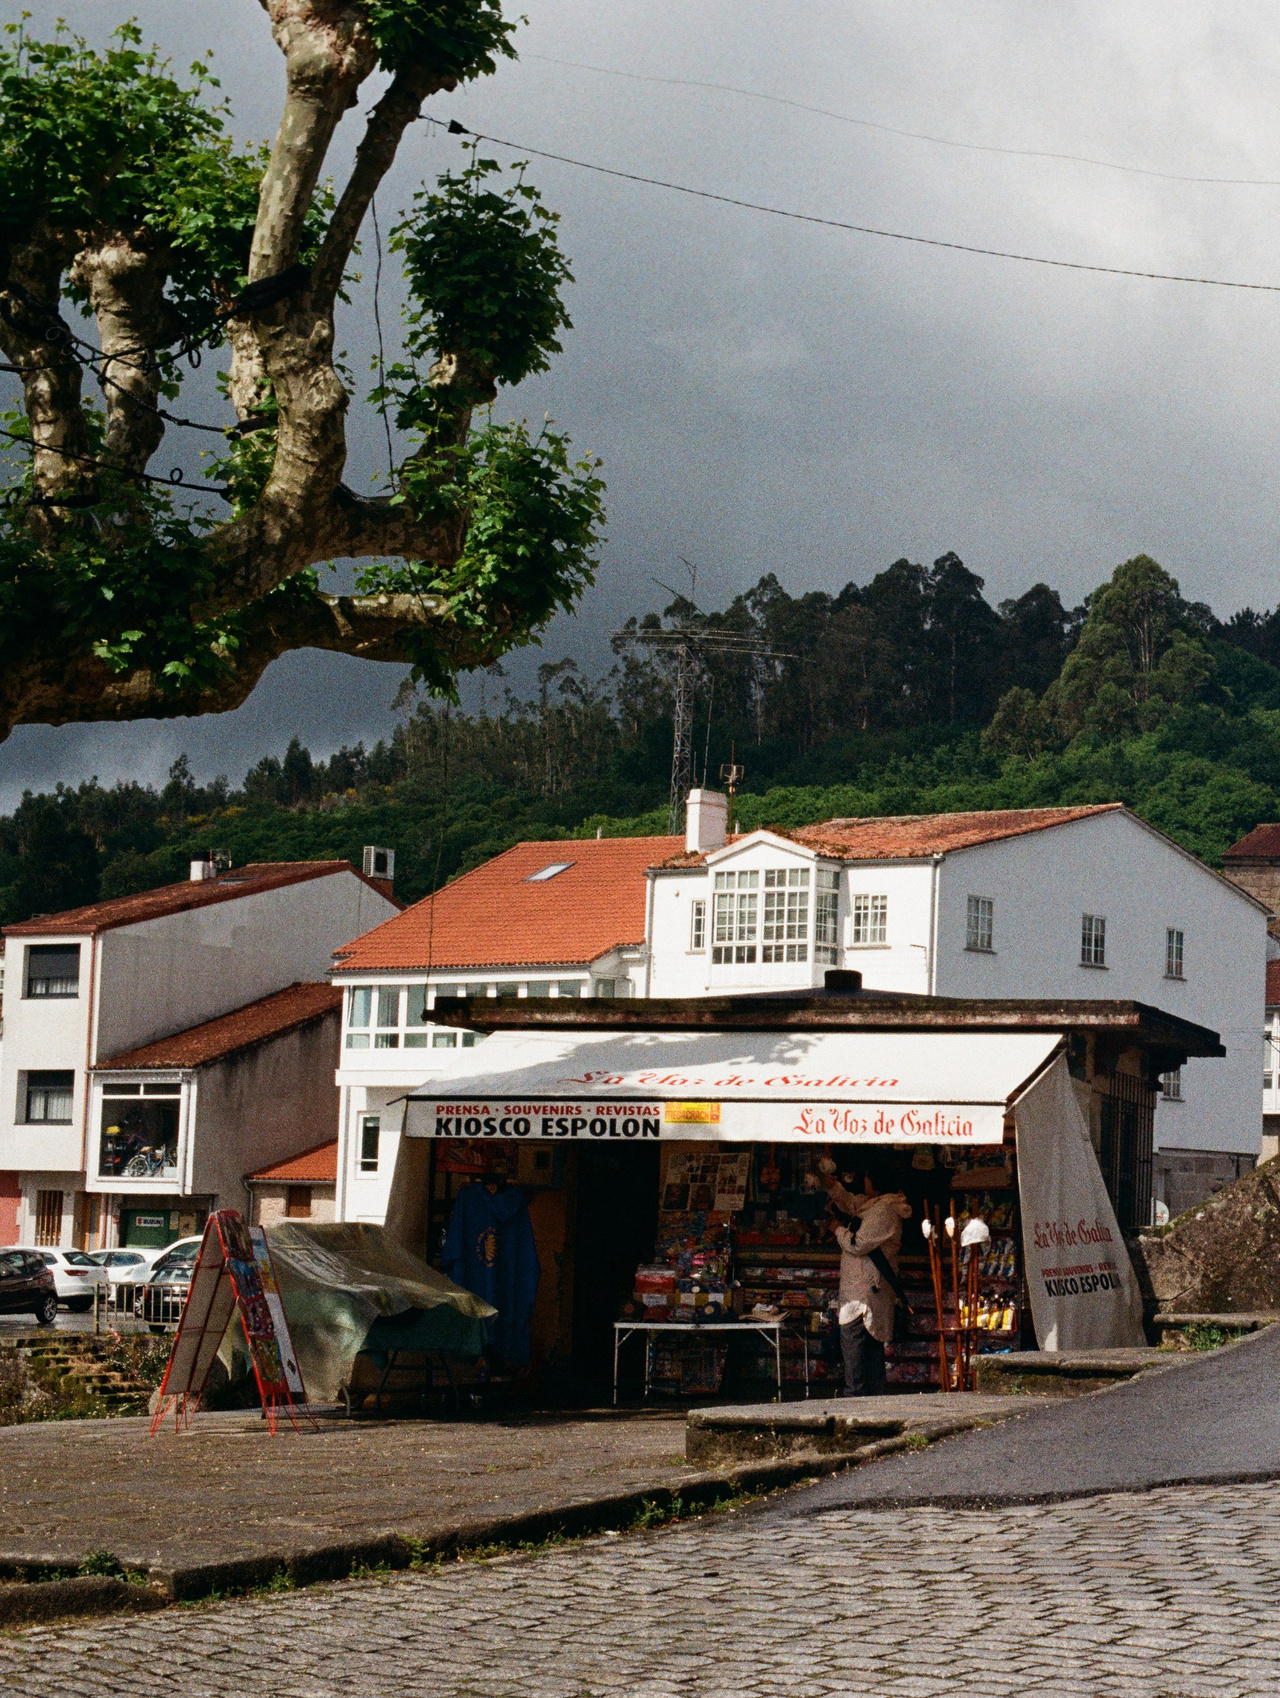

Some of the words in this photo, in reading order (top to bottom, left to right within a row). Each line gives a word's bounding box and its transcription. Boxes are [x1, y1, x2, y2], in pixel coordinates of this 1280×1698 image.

[557, 1071, 625, 1085] La
[638, 1072, 706, 1086] Voz
[713, 1074, 755, 1087] de
[763, 1074, 900, 1087] Galicia
[435, 1105, 491, 1116] PRENSA
[504, 1105, 583, 1116] SOUVENIRS
[595, 1105, 661, 1117] REVISTAS
[434, 1117, 532, 1137] KIOSCO
[541, 1117, 661, 1138] ESPOLON
[792, 1107, 827, 1135] La
[828, 1108, 869, 1138] Voz
[873, 1109, 895, 1136] de
[899, 1109, 974, 1137] Galicia
[1034, 1222, 1050, 1249] La
[1063, 1221, 1078, 1247] de
